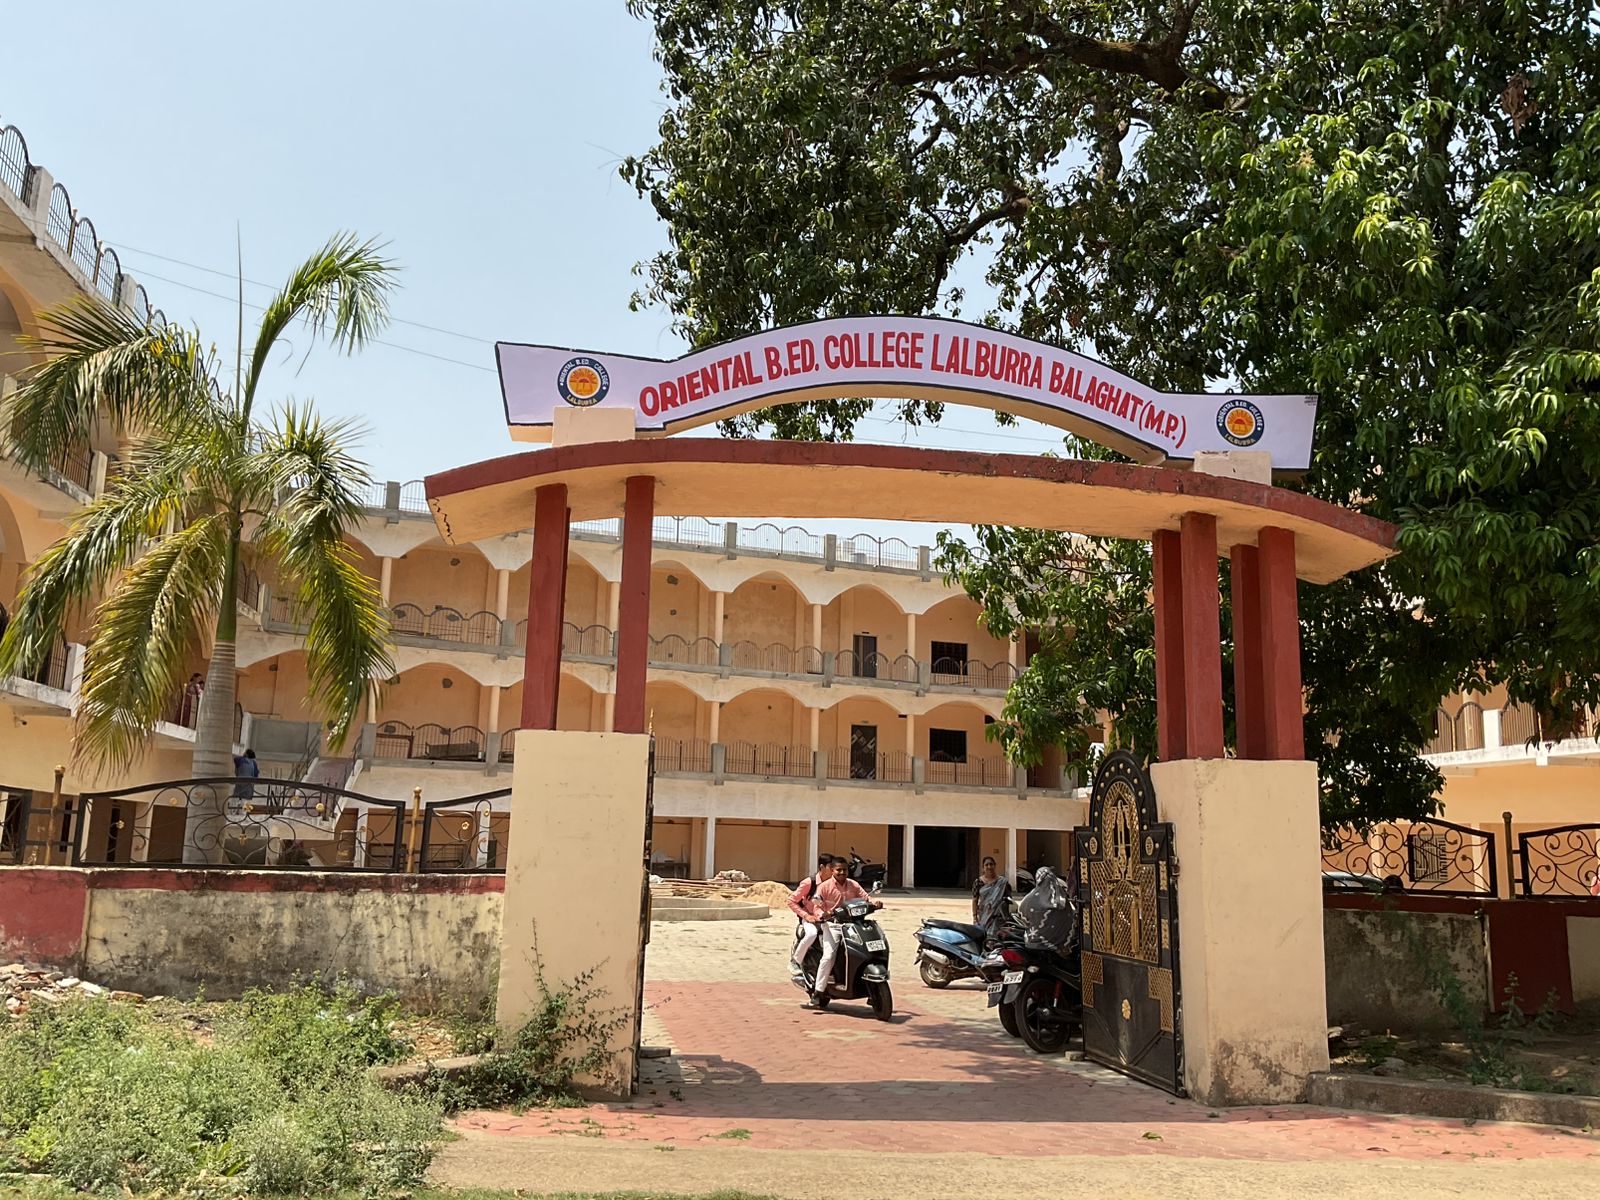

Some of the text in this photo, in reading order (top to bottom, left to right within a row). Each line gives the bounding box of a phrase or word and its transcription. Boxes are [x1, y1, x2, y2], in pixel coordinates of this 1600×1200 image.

[639, 352, 763, 417] ORIENTAL
[764, 339, 820, 380] B.ED.
[824, 332, 924, 370] COLLEGE
[931, 333, 1043, 390] LALBURRA
